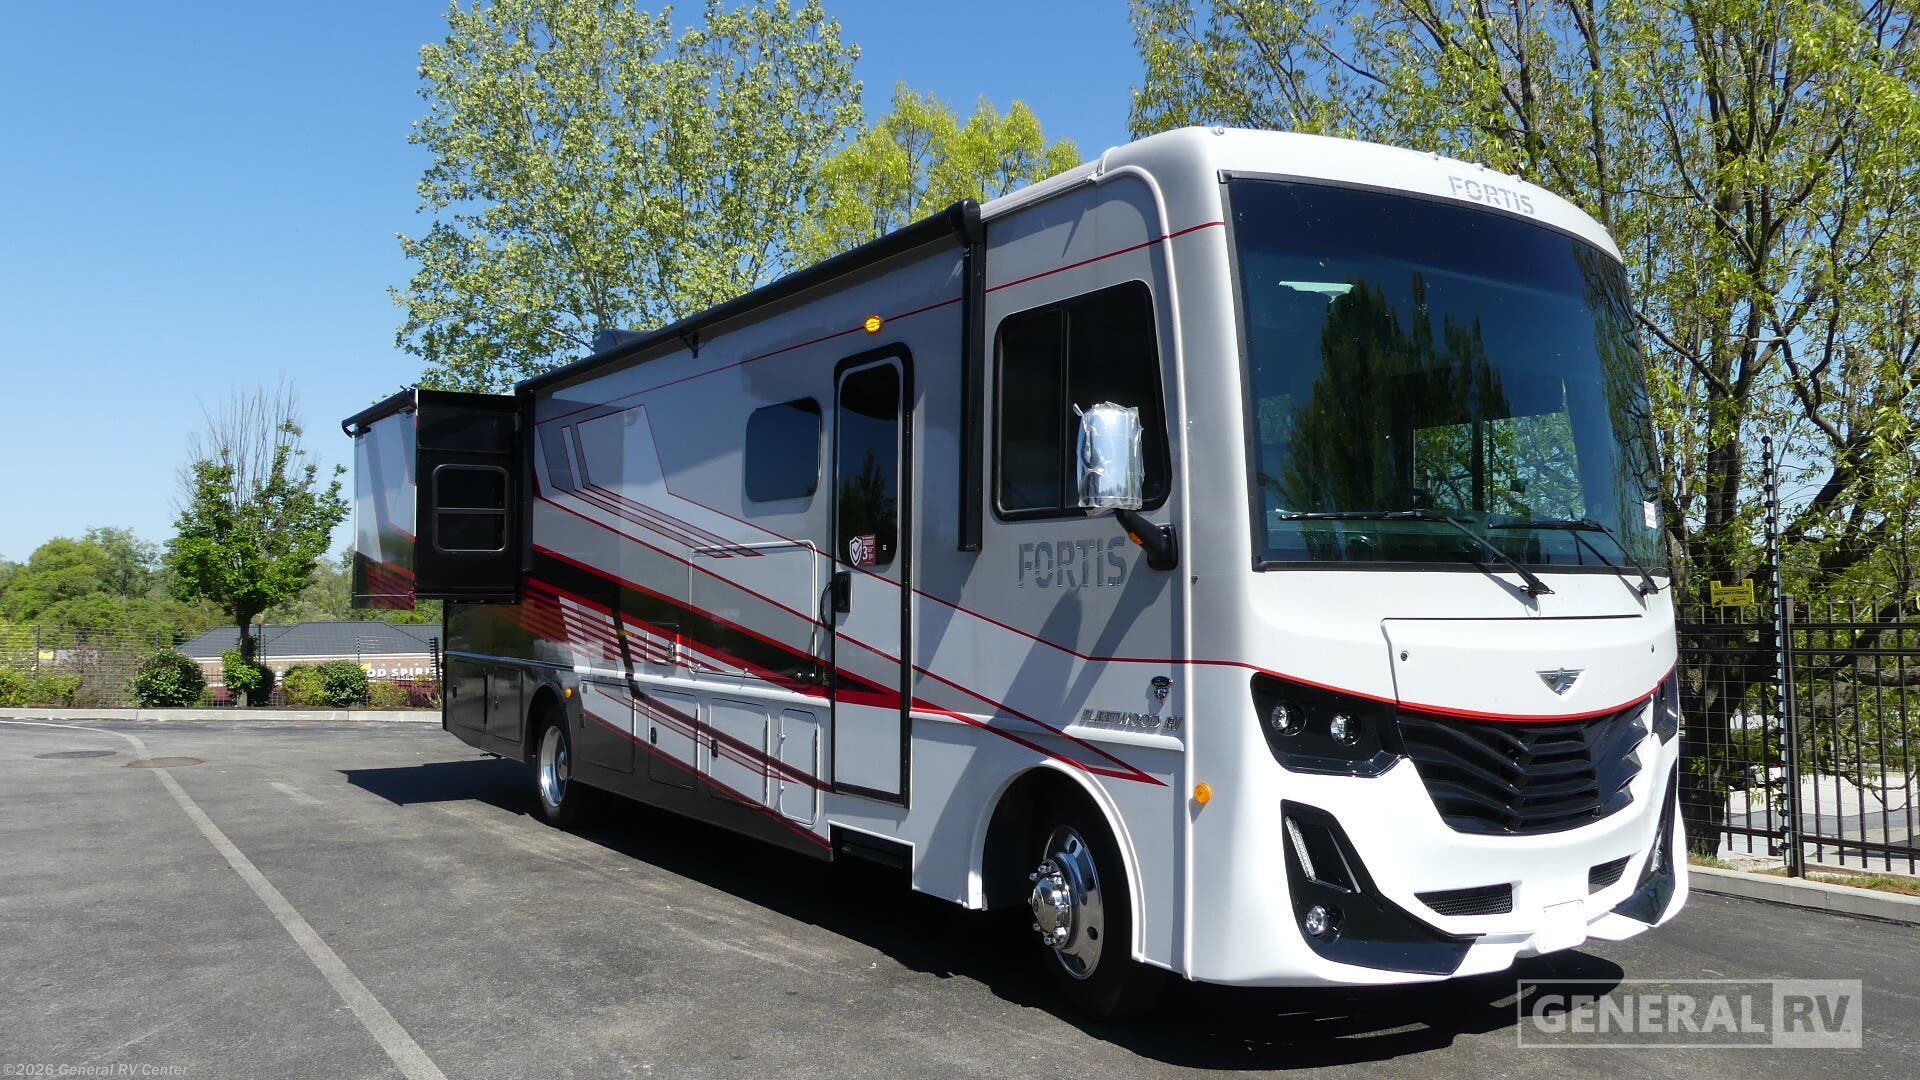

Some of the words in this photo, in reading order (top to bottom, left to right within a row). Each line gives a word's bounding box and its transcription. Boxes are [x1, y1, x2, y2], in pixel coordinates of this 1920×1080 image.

[1448, 175, 1534, 214] FORTIS
[1018, 536, 1127, 588] FORTIS
[365, 667, 387, 679] OD
[1081, 709, 1161, 728] FLEETWOOD
[1163, 715, 1183, 731] RV
